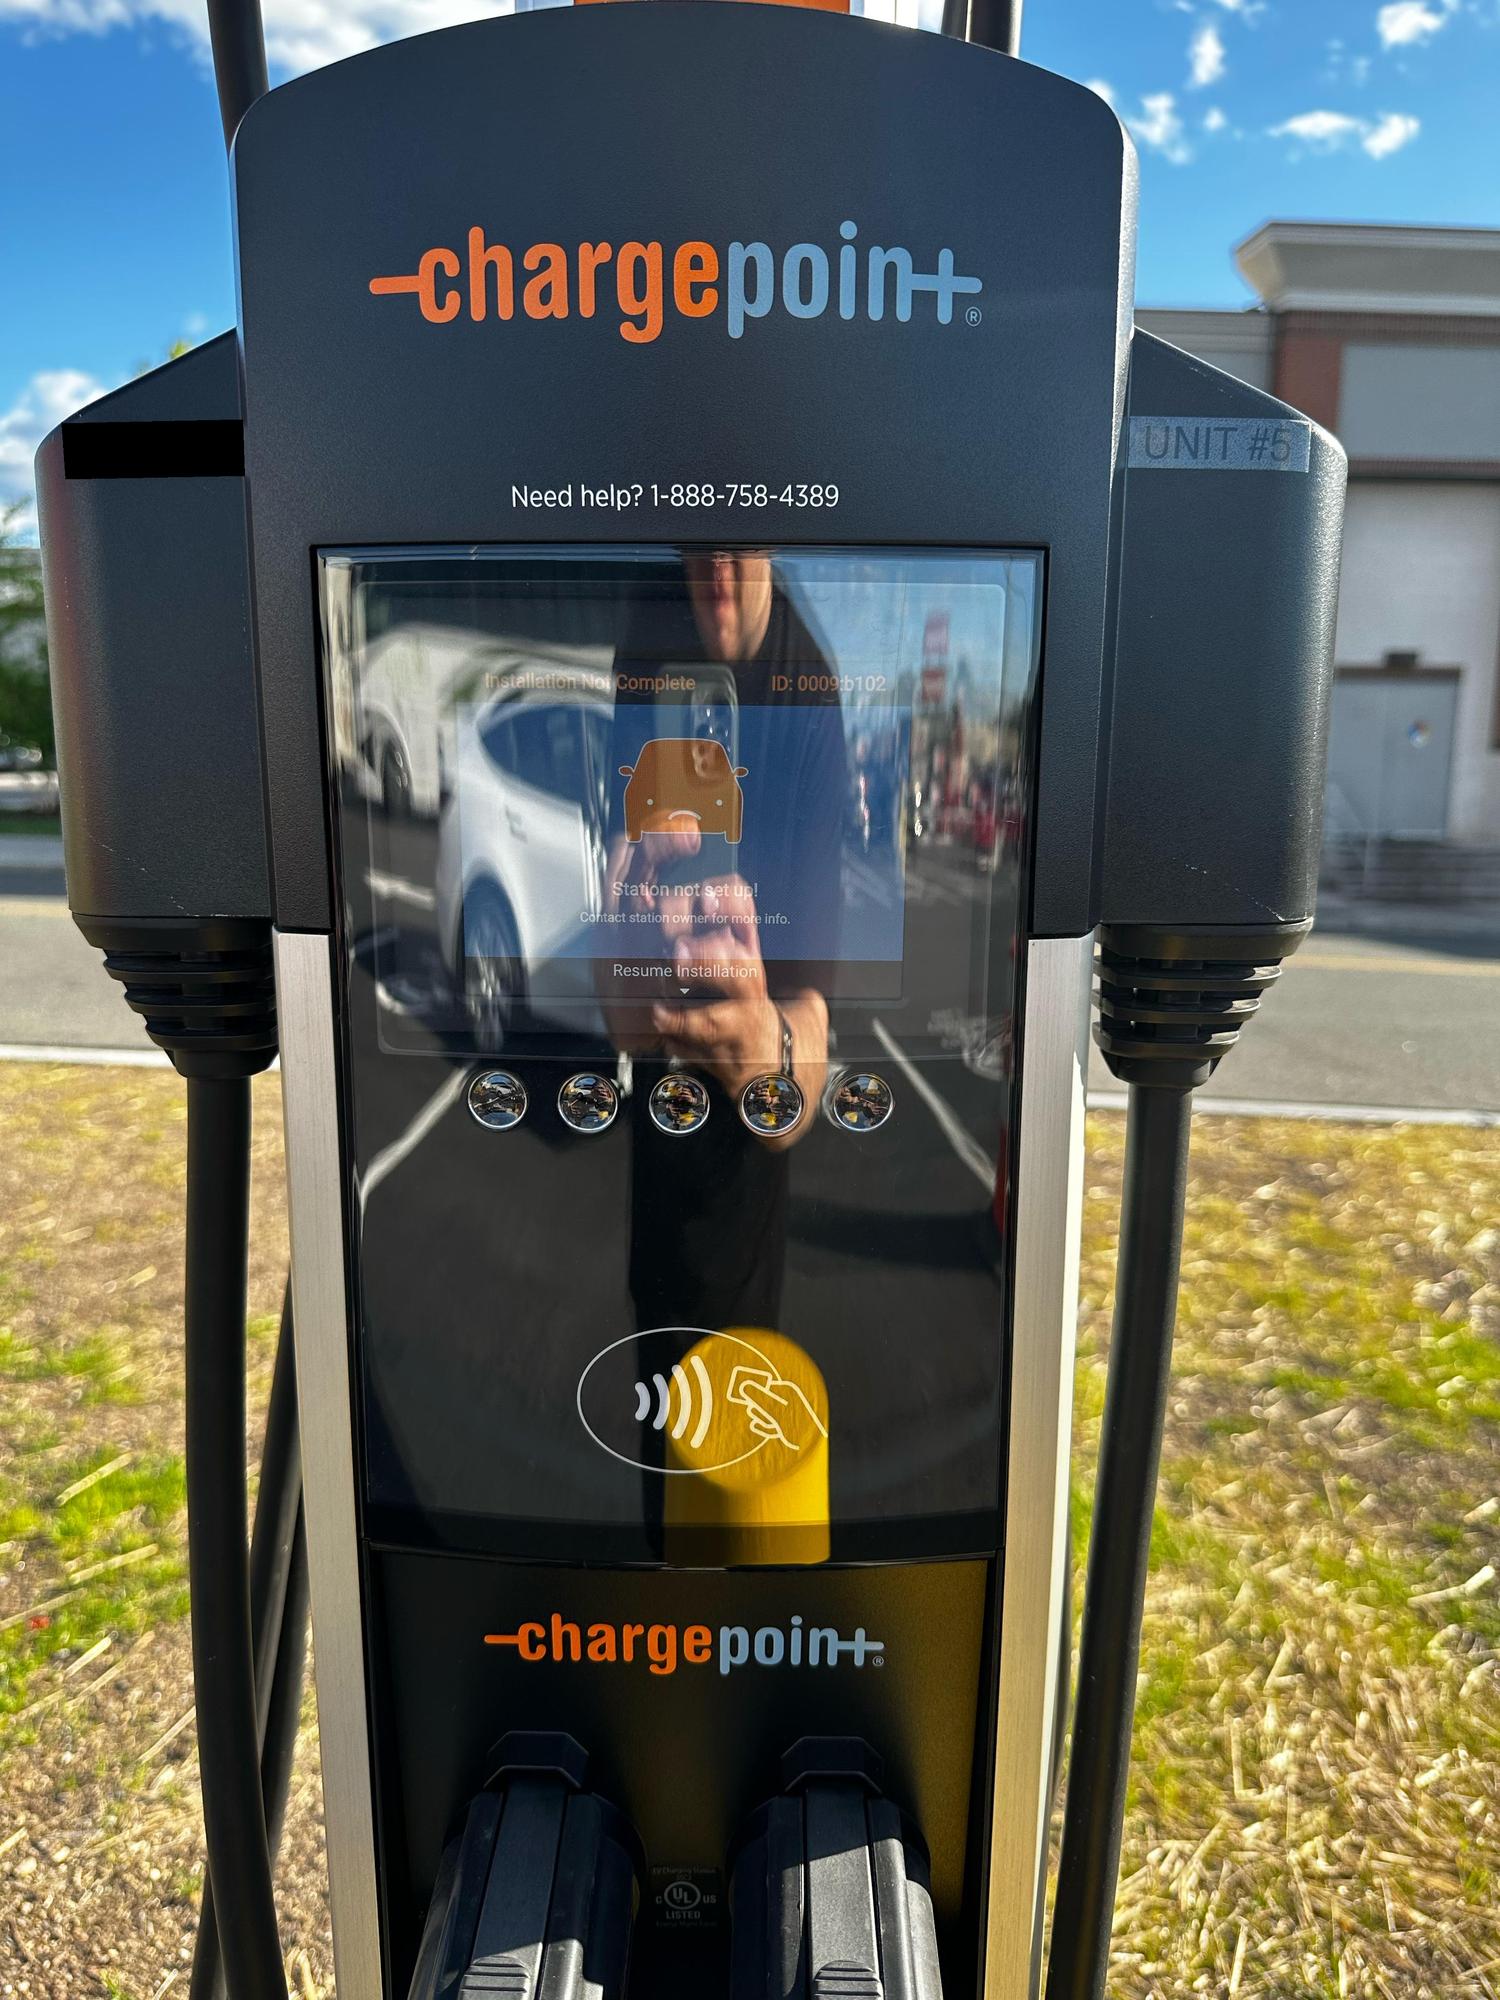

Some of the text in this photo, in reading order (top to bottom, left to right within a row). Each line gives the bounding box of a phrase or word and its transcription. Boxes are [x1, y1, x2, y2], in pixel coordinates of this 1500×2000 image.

[1144, 425, 1291, 462] UNIT #5
[511, 484, 840, 511] Need help? 1-888-758-4389
[485, 672, 696, 694] Installation Not Complete
[771, 675, 887, 692] ID: 0009:b102
[612, 881, 758, 901] Station not set up!
[580, 911, 791, 925] Contact station owner for more info.
[613, 963, 758, 979] Resume Installation
[672, 1887, 692, 1904] UL
[665, 1911, 701, 1920] LISTED
